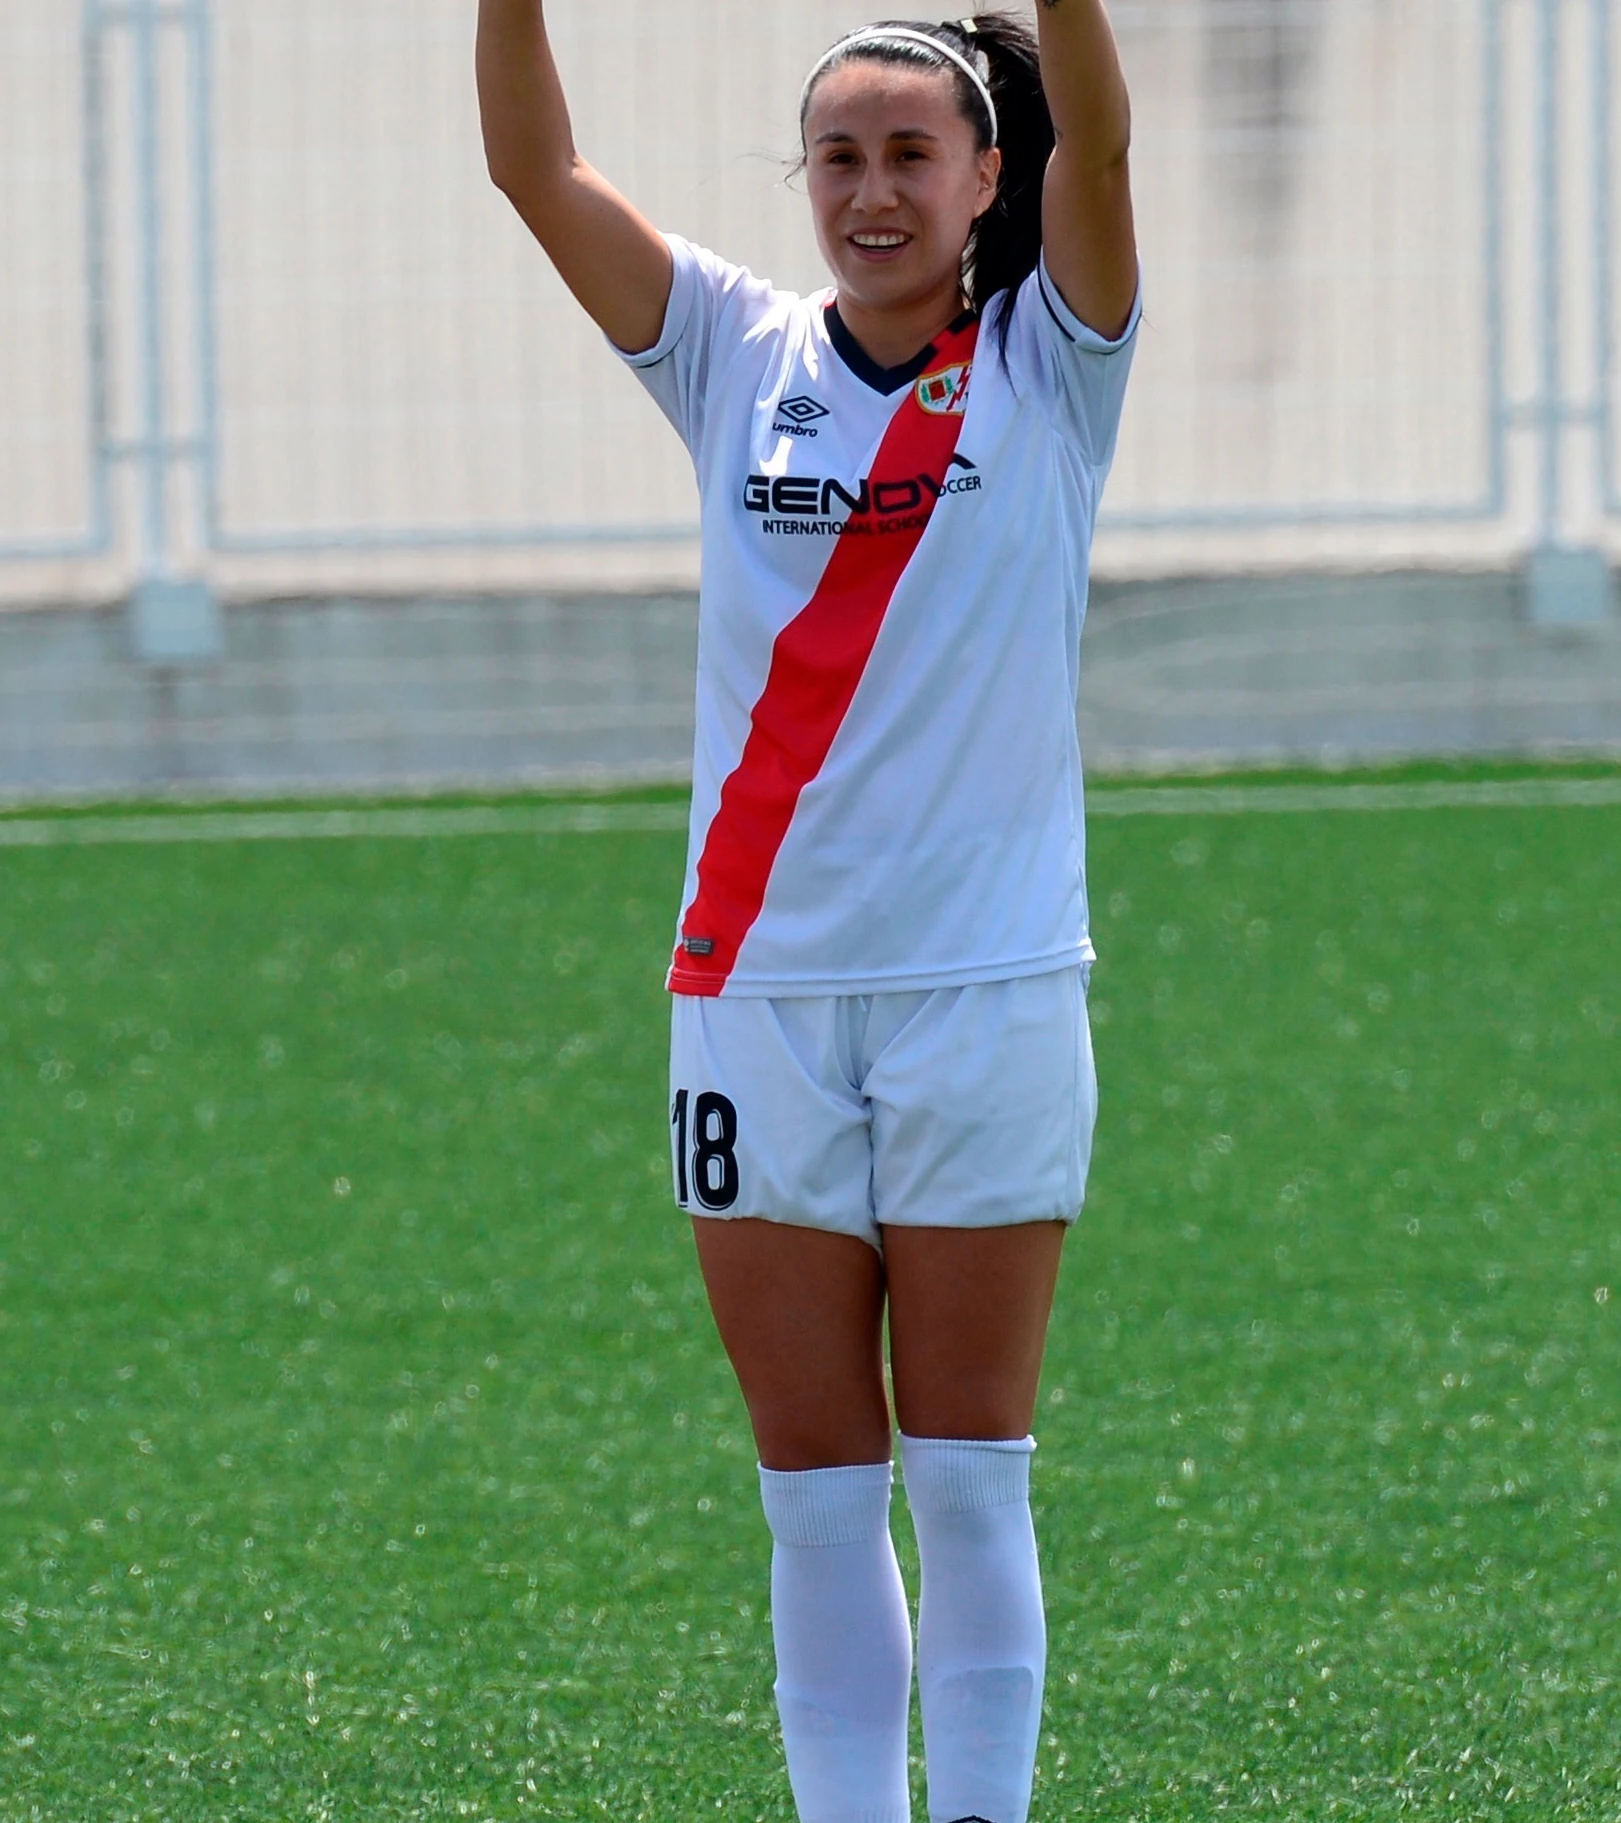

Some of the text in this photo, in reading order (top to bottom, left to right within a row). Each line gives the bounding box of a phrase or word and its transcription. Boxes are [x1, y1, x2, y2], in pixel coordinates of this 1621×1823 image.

[771, 422, 818, 438] umbro
[762, 519, 873, 536] INTERNATIONAL
[938, 475, 982, 497] OCCER
[671, 1088, 739, 1211] 18
